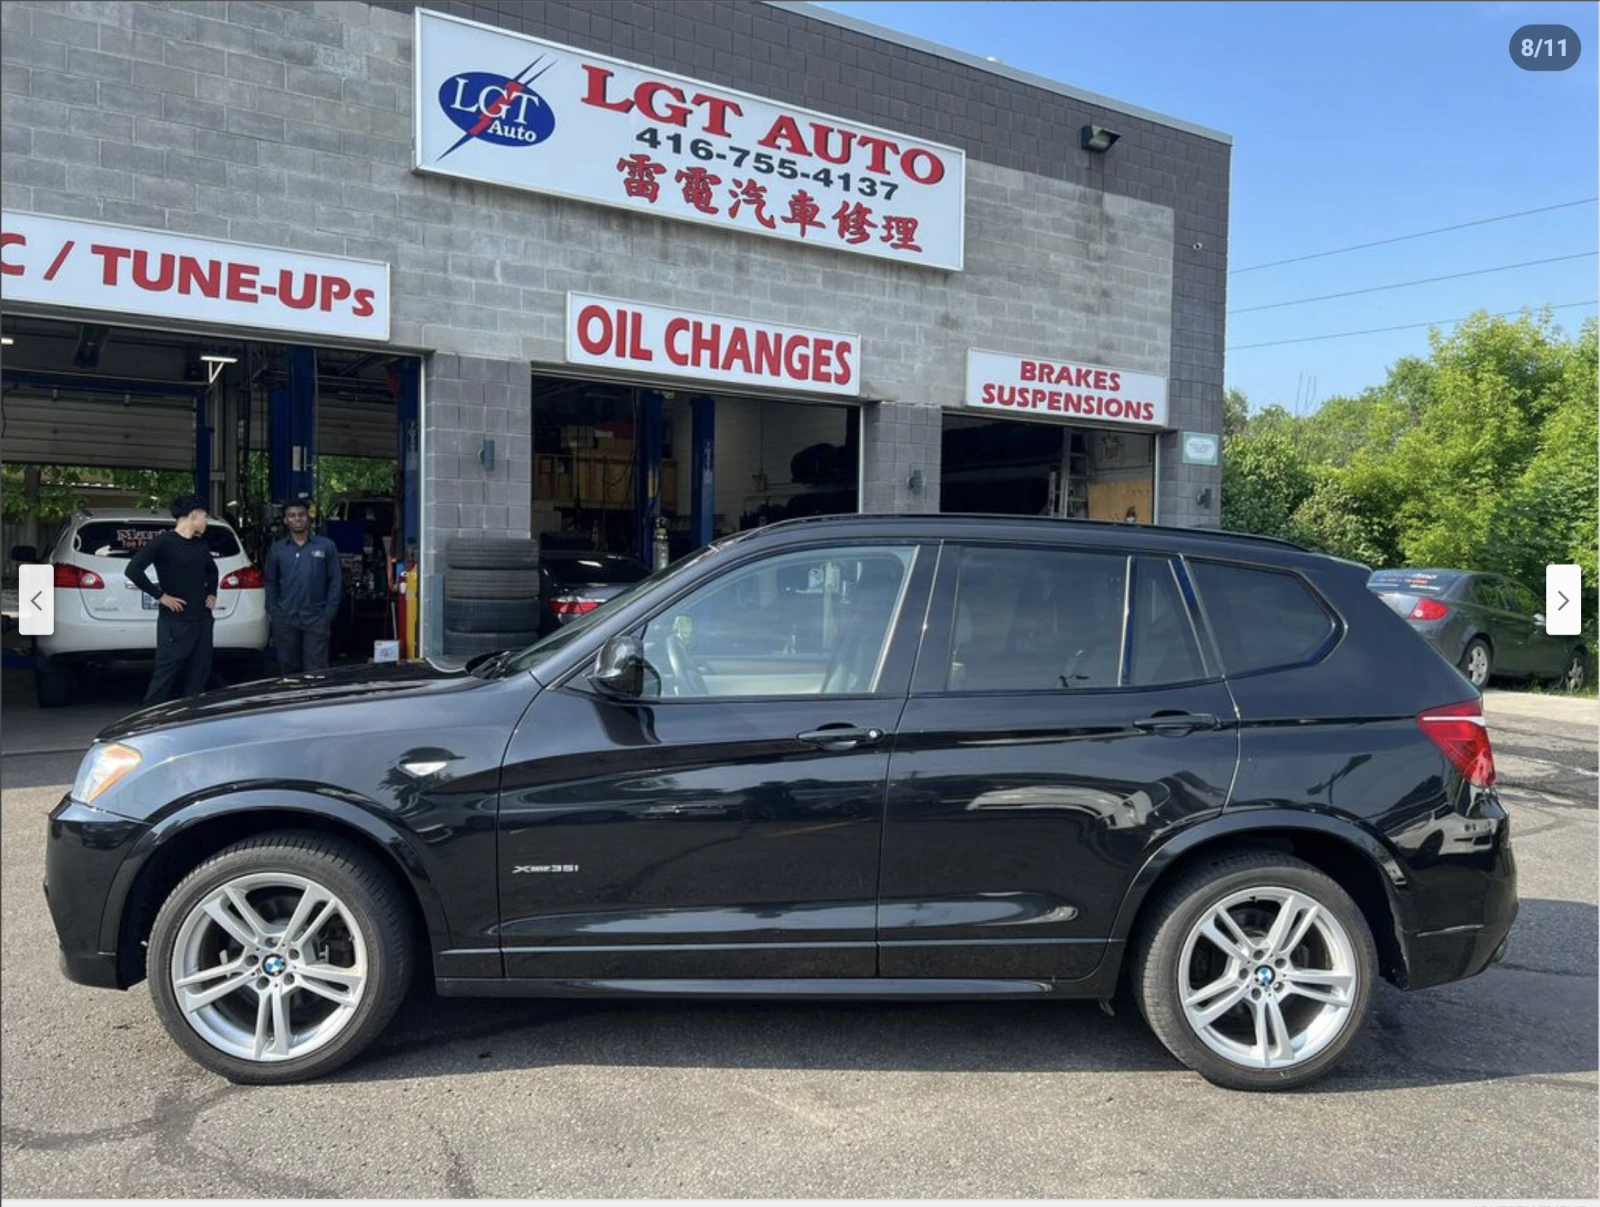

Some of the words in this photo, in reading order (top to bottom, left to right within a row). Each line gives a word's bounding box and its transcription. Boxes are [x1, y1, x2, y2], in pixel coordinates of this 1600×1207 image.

[451, 79, 539, 124] LGT
[487, 120, 537, 142] Auto
[581, 64, 742, 138] LGT
[758, 115, 946, 187] AUTO
[635, 127, 899, 201] 416-755-4137
[616, 153, 922, 253] 雷電汽車修理
[91, 243, 375, 318] TUNE-UPs
[576, 304, 652, 361] OIL
[663, 317, 852, 385] CHANGES
[1020, 361, 1121, 392] BRAKES
[983, 384, 1154, 420] SUSPENSIONS
